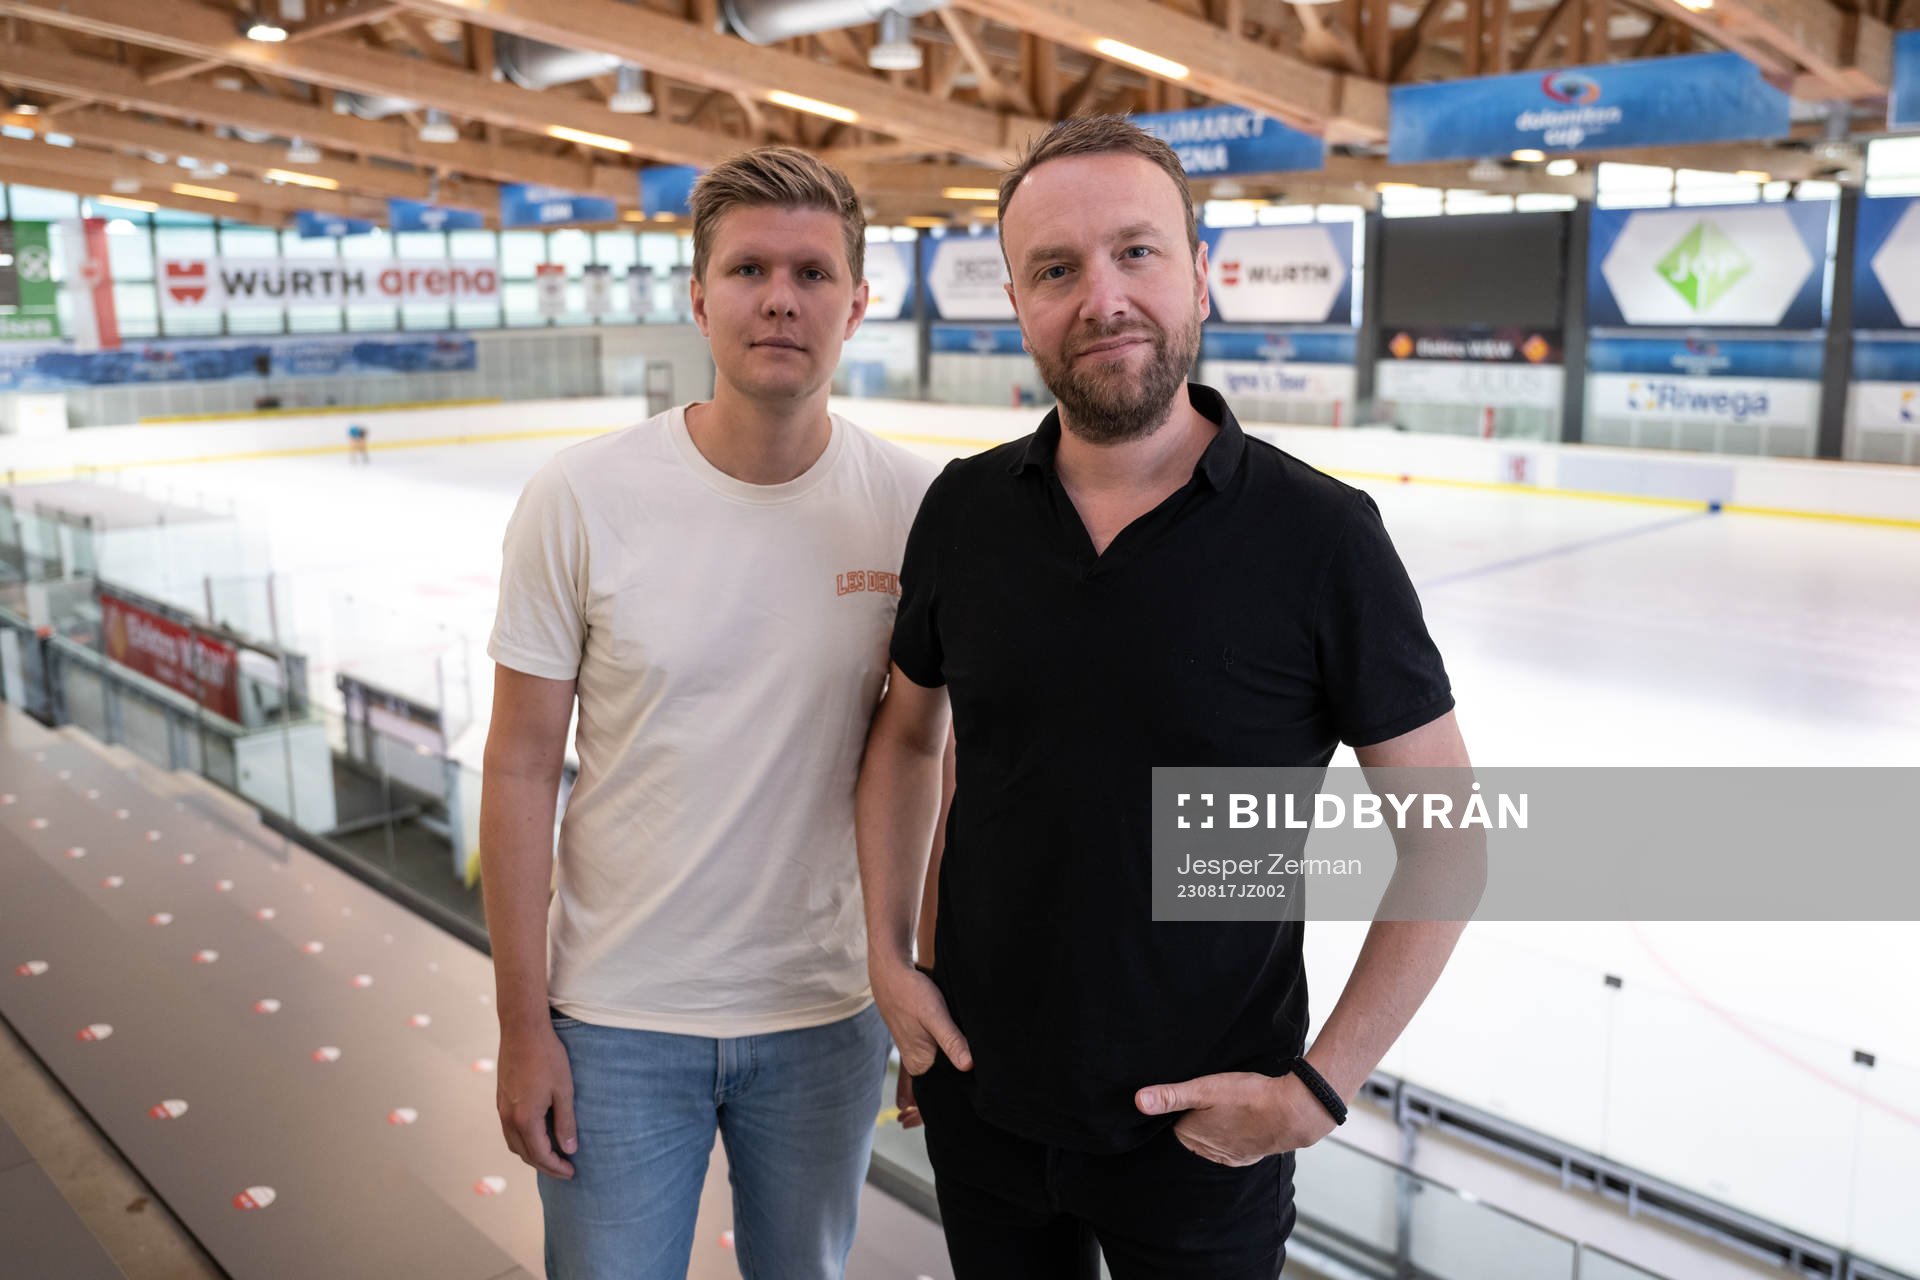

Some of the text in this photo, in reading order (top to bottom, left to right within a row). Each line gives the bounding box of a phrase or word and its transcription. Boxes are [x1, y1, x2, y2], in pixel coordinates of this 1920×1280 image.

[219, 266, 497, 297] WÜRTH arena
[1657, 381, 1770, 421] Riwega
[836, 570, 866, 597] LES
